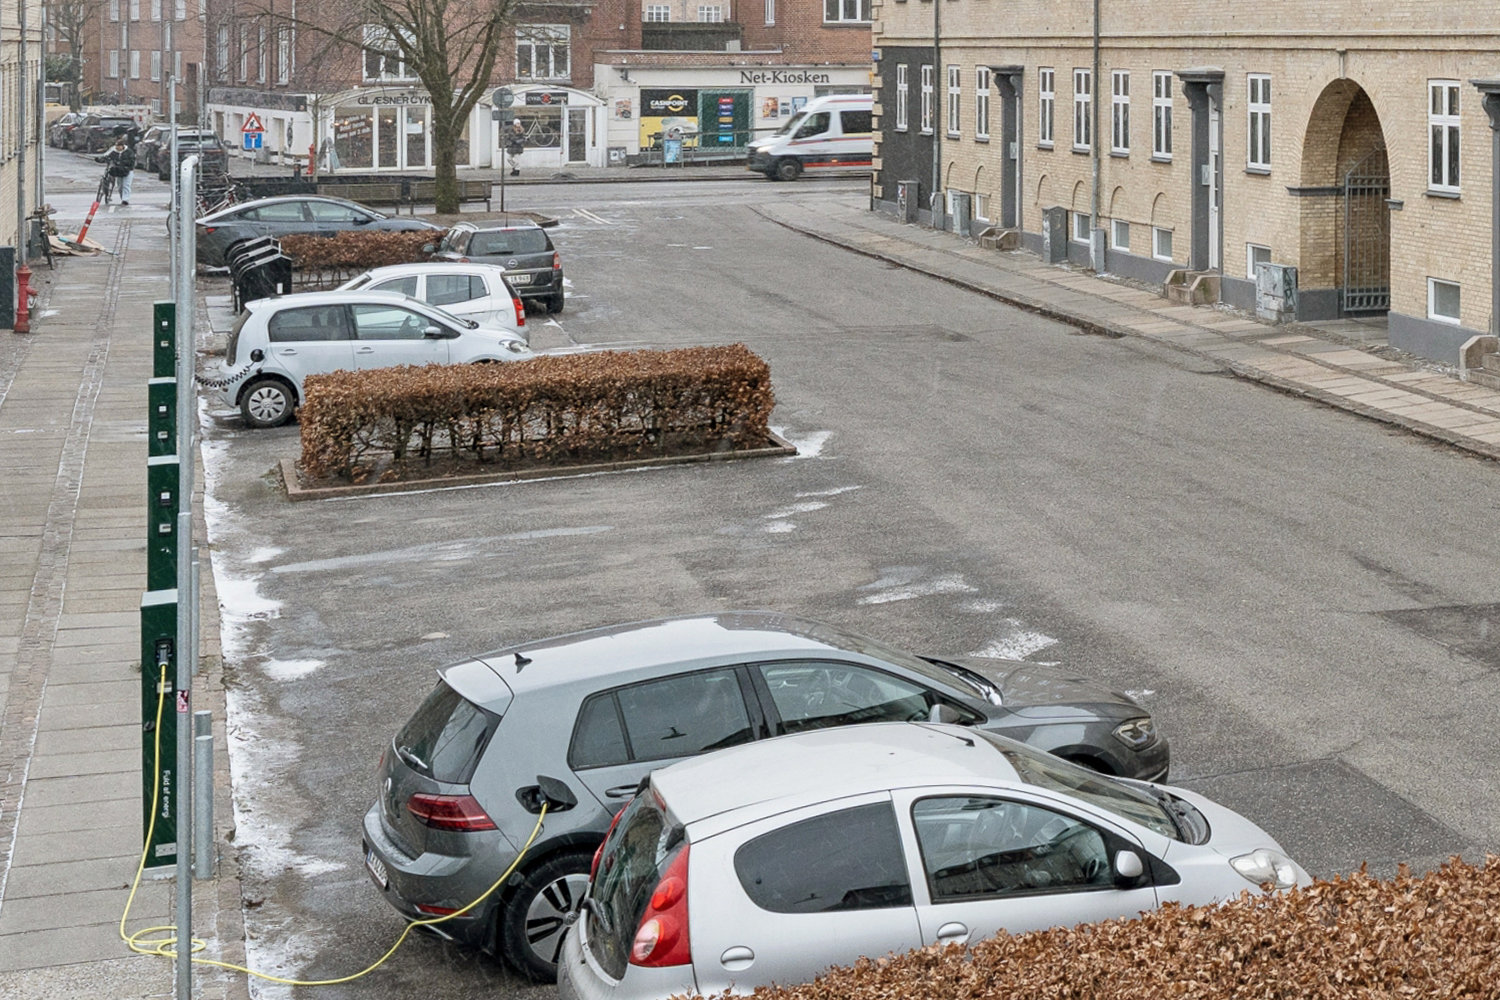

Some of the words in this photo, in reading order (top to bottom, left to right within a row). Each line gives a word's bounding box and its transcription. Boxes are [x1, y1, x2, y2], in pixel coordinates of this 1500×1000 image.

[740, 70, 830, 84] Net-Kiosken
[357, 96, 409, 105] GLÆSNER
[410, 95, 431, 104] CYK
[162, 770, 171, 785] Fuld
[162, 787, 170, 795] af
[161, 796, 170, 818] energi
